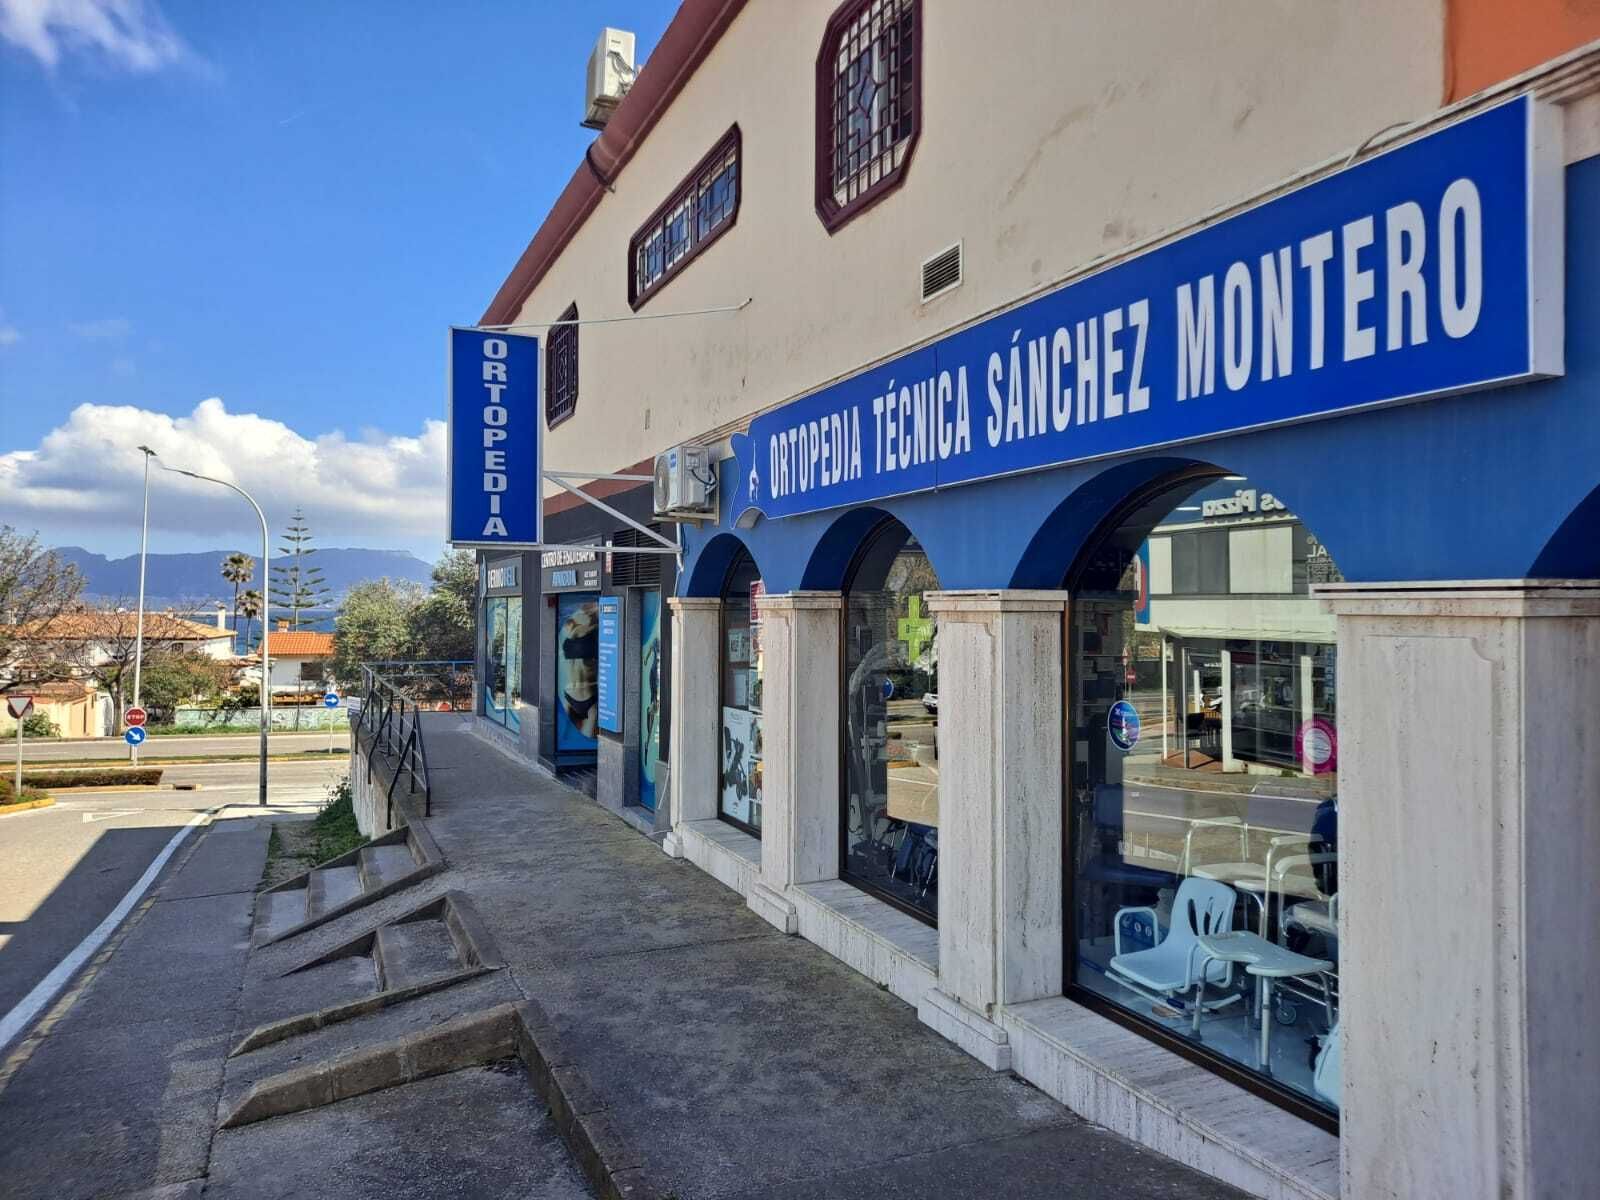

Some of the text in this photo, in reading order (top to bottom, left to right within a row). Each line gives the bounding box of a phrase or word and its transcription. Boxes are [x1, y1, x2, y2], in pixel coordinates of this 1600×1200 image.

[482, 339, 508, 536] ORTOPEDIA
[769, 177, 1483, 499] ORTOPEDIA TÉCNICA SÁNCHEZ MONTERO
